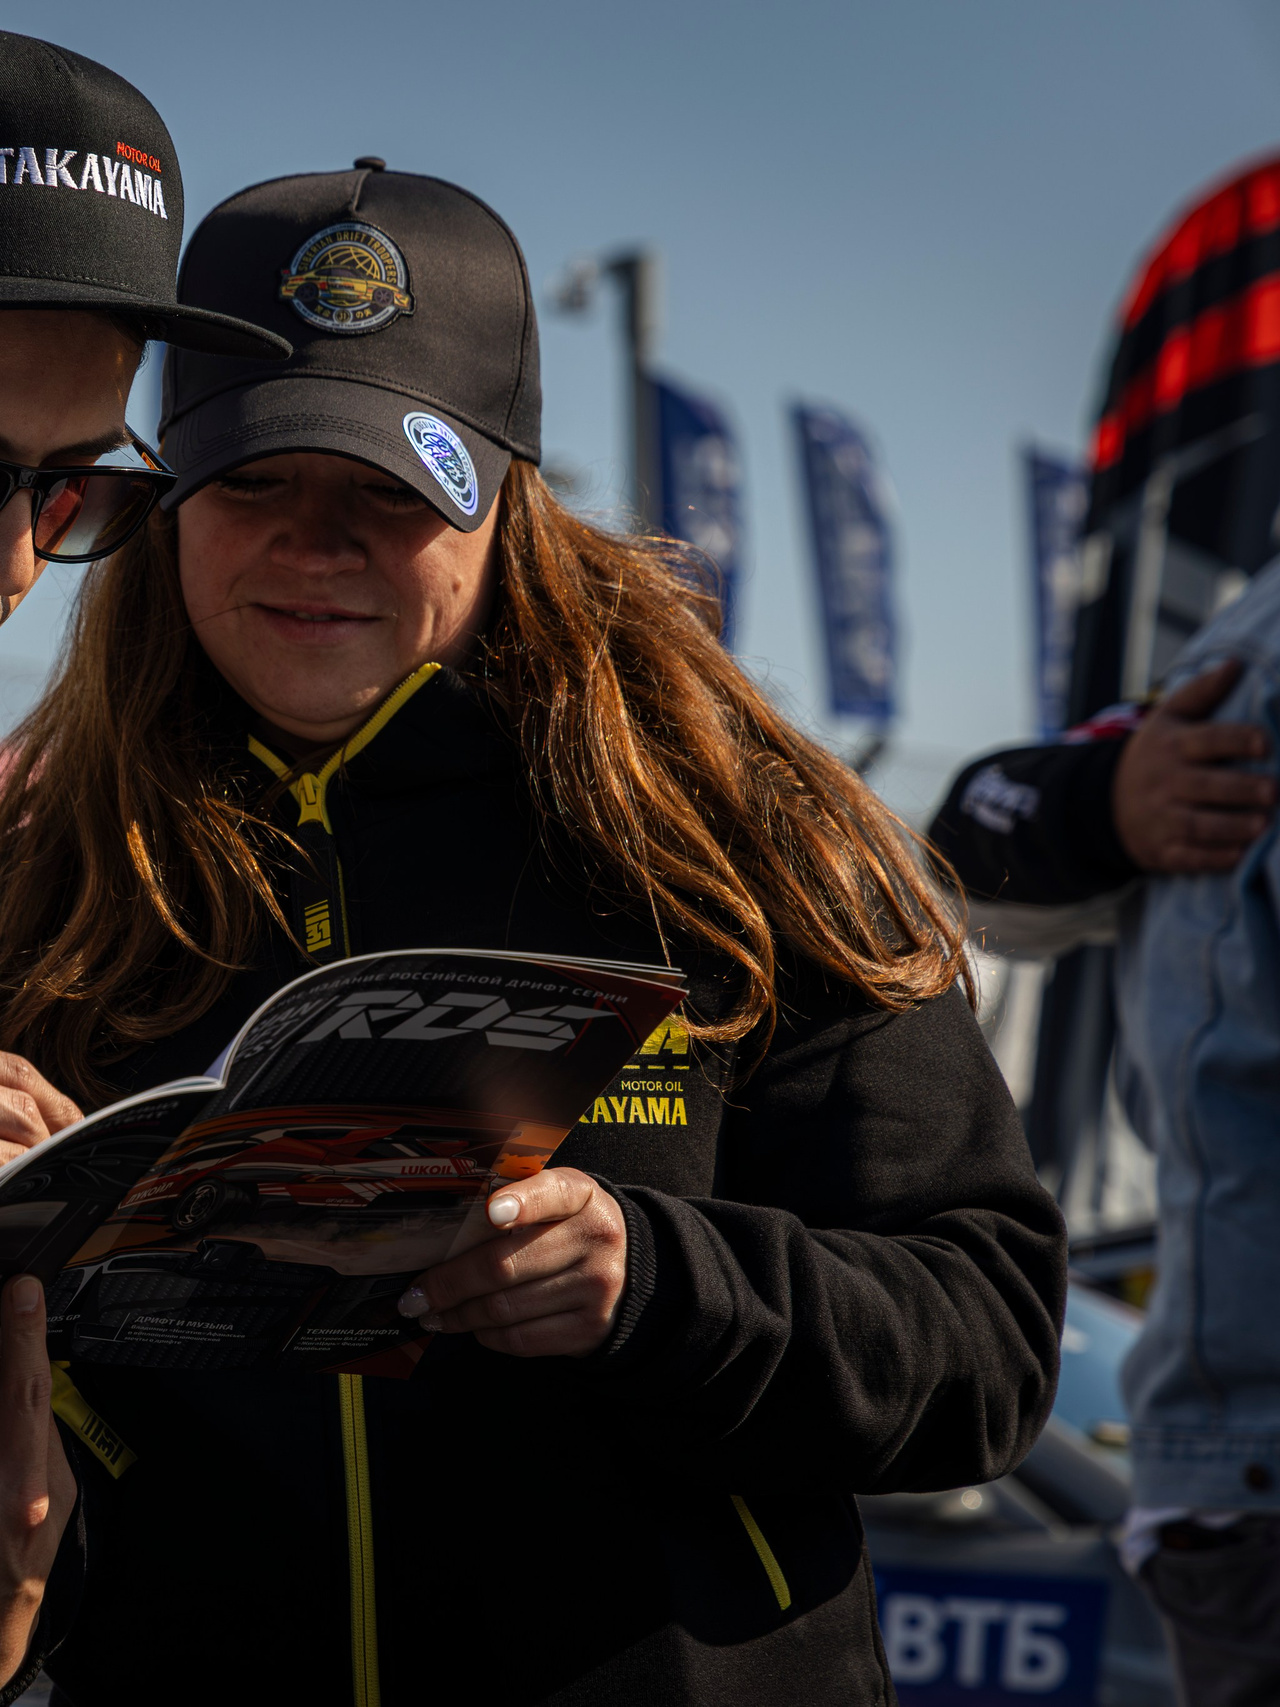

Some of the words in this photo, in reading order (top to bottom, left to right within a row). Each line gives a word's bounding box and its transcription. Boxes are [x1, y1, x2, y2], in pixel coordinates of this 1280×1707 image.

[116, 141, 148, 168] MOTOR
[336, 231, 367, 243] DRIFT
[367, 237, 398, 284] TROOPERS
[388, 971, 503, 986] РОССИЙСКОЙ
[504, 979, 568, 994] ДРИФТ
[571, 987, 629, 1004] СЕРИИ
[297, 989, 619, 1052] RDS
[620, 1080, 663, 1091] MOTOR
[665, 1081, 684, 1092] OIL
[400, 1165, 453, 1176] LUKOIL
[134, 1316, 176, 1326] ДРИФТ
[176, 1319, 186, 1327] И
[186, 1320, 234, 1331] МУЗЫКА
[354, 1328, 400, 1336] ДРИФТА
[882, 1593, 1068, 1692] ВТБ
